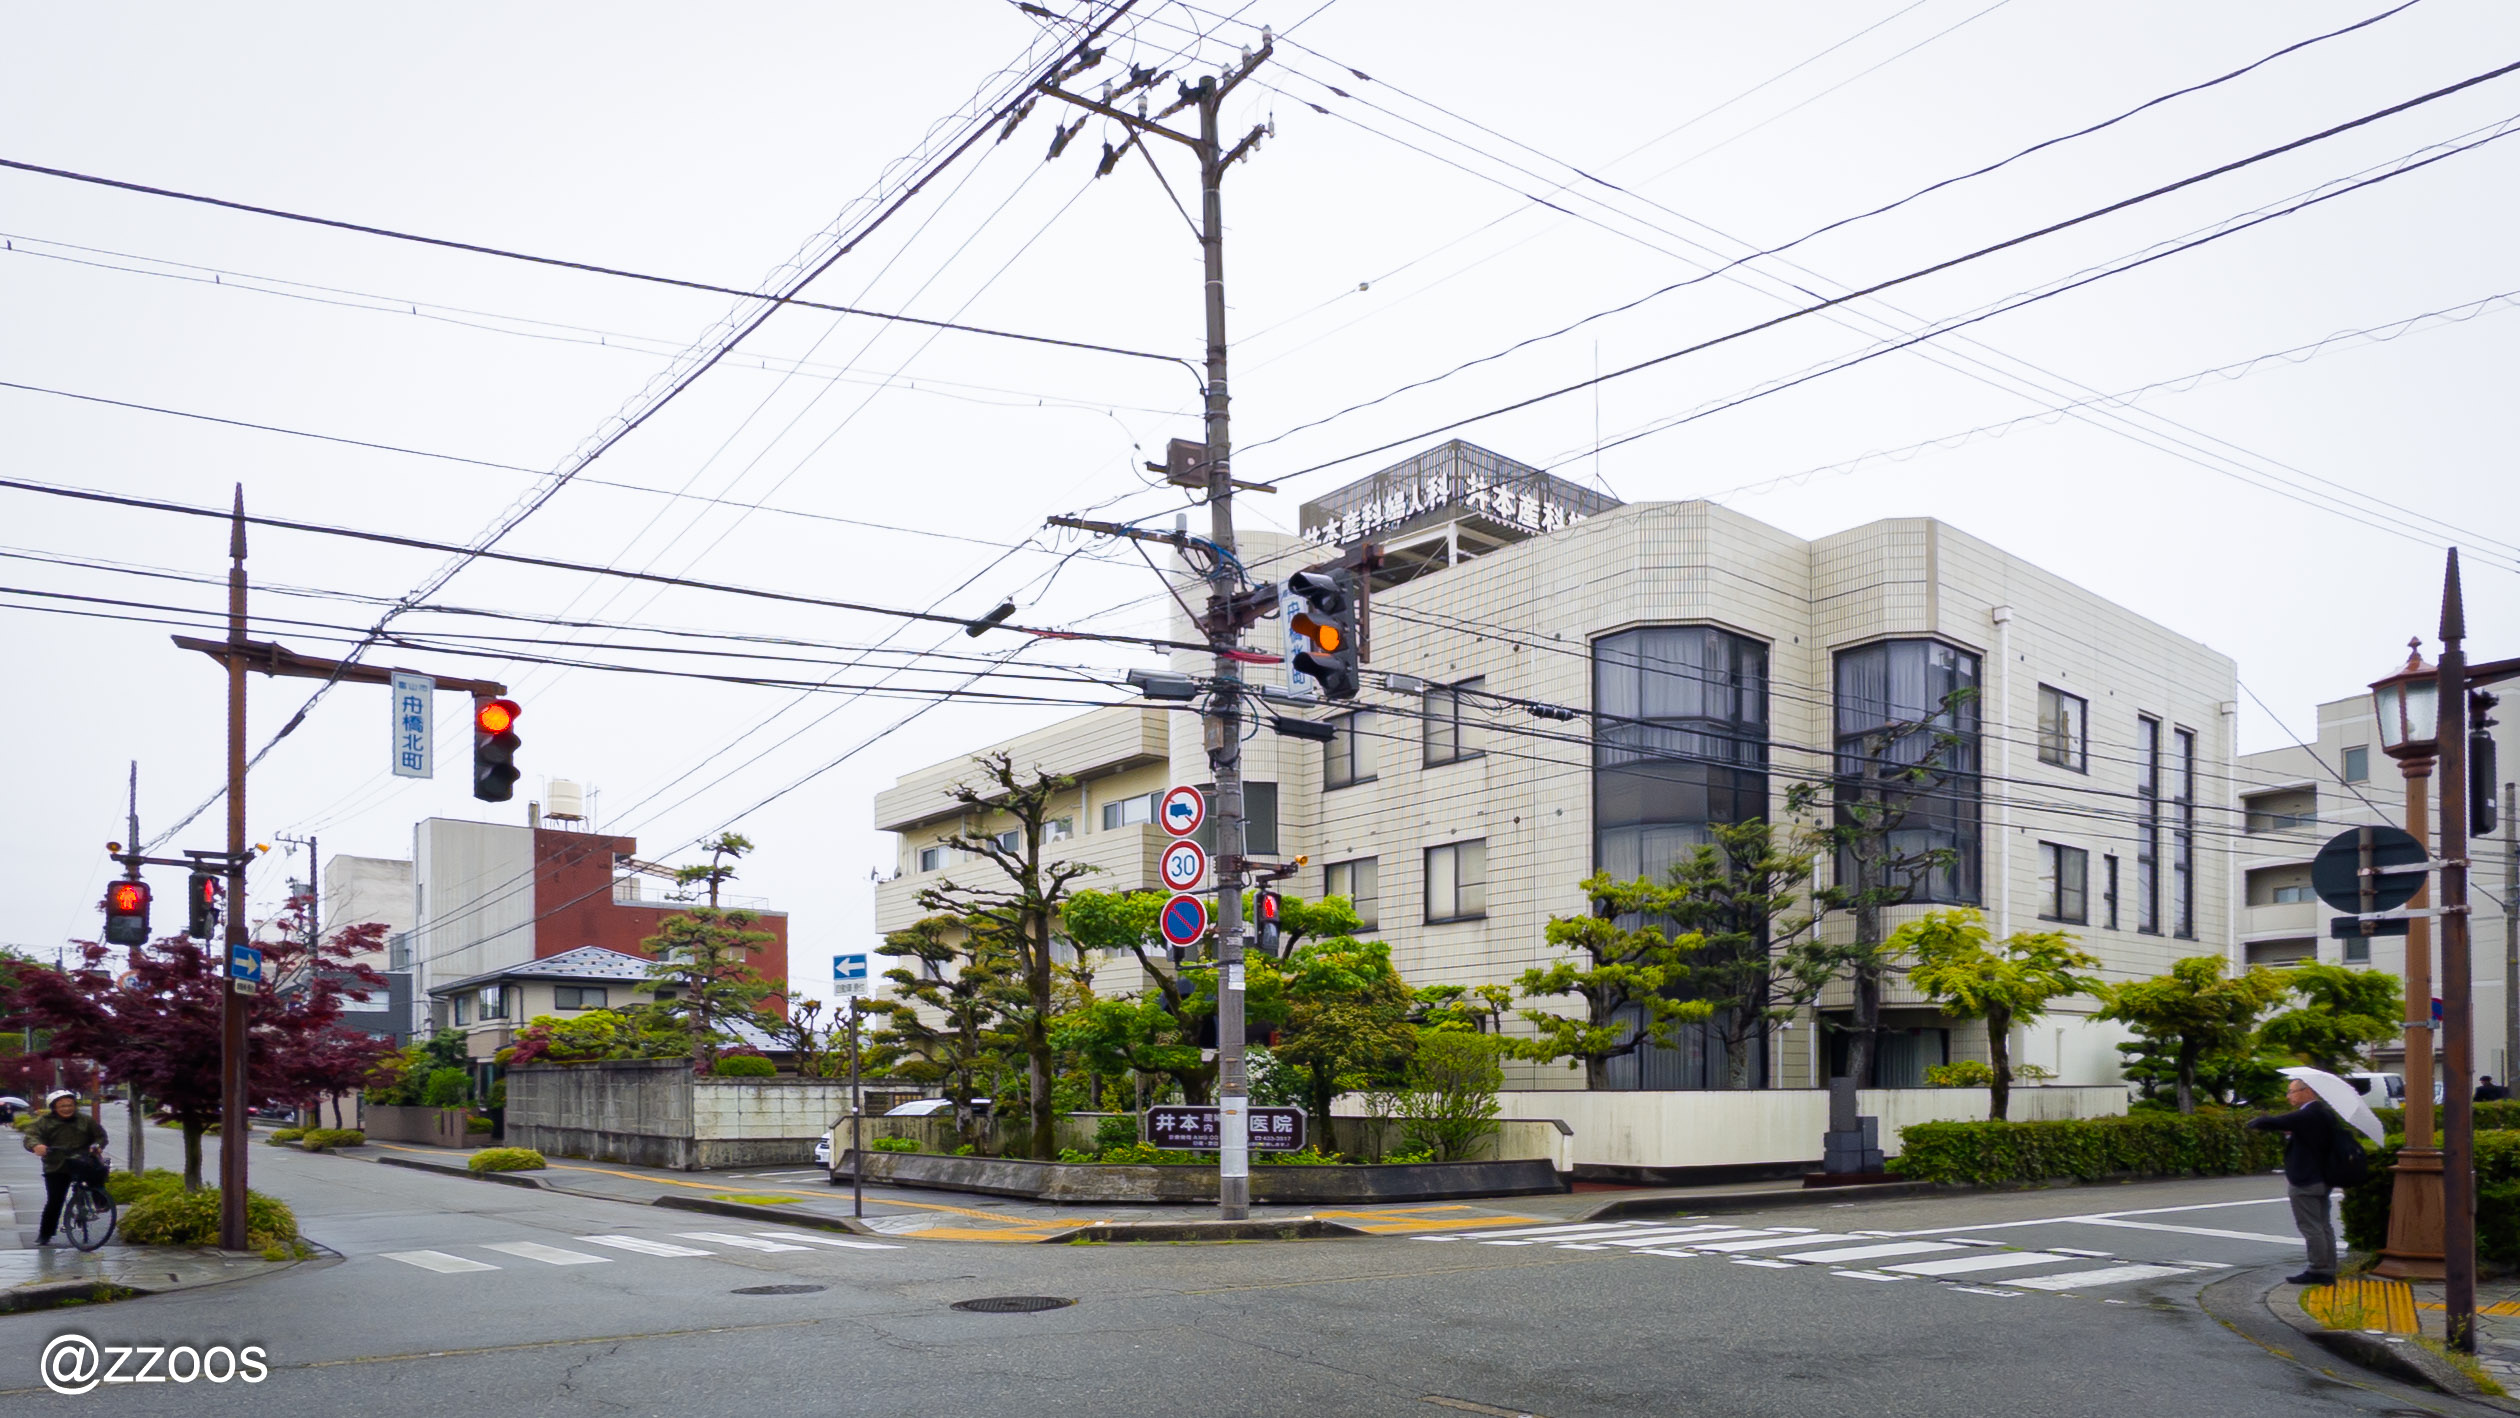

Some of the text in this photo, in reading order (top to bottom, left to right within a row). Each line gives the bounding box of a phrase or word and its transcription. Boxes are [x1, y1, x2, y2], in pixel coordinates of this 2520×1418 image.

[402, 695, 424, 770] 舟橋北町
[1171, 854, 1196, 878] 30
[1155, 1113, 1294, 1133] 井本 医院
